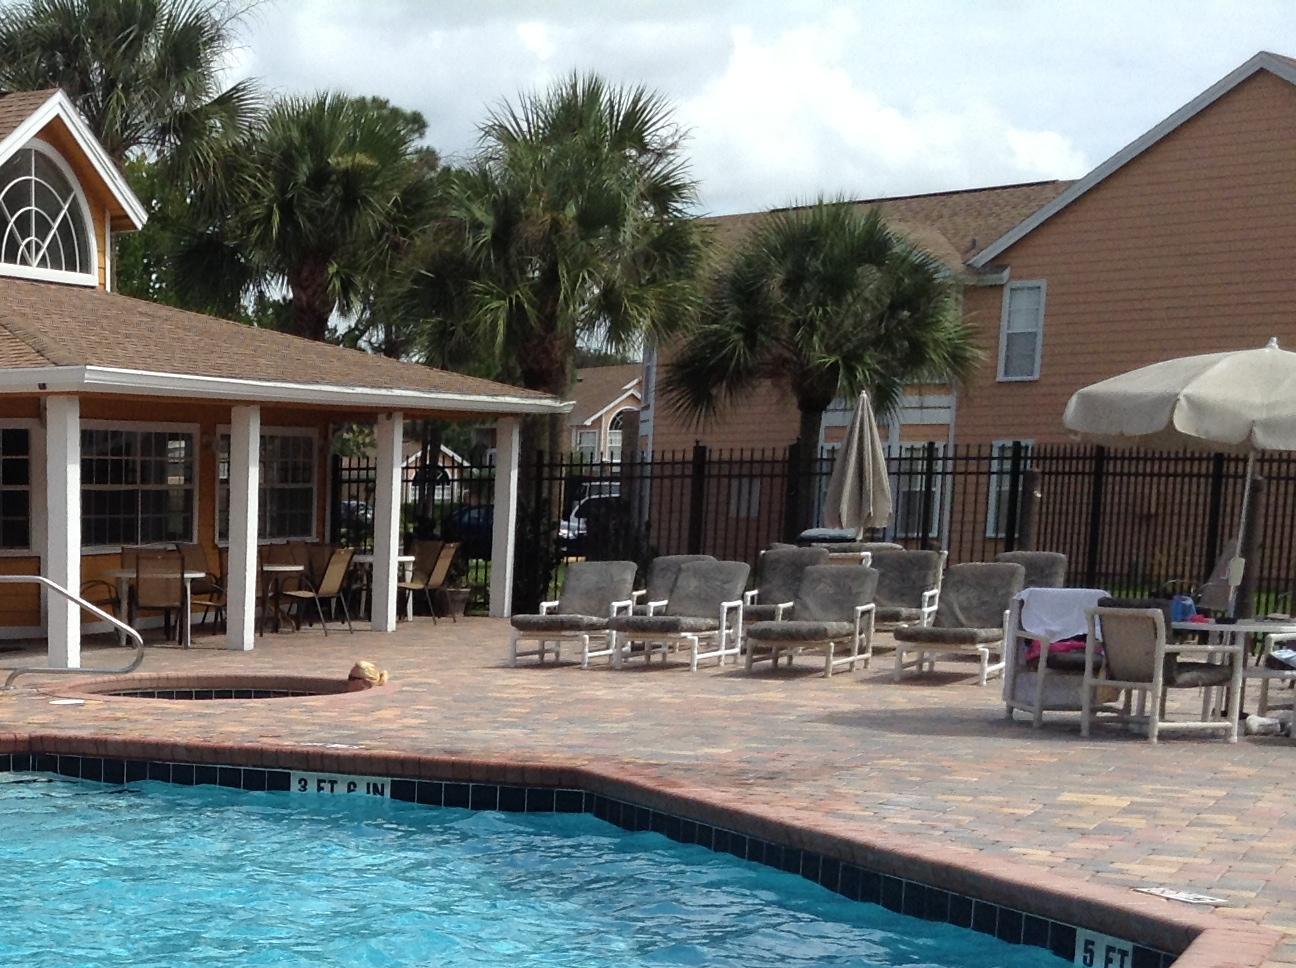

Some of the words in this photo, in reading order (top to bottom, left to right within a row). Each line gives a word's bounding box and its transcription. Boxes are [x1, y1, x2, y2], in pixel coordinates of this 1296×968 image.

[297, 777, 308, 793] 3
[316, 778, 338, 794] FT
[1083, 939, 1096, 968] 5
